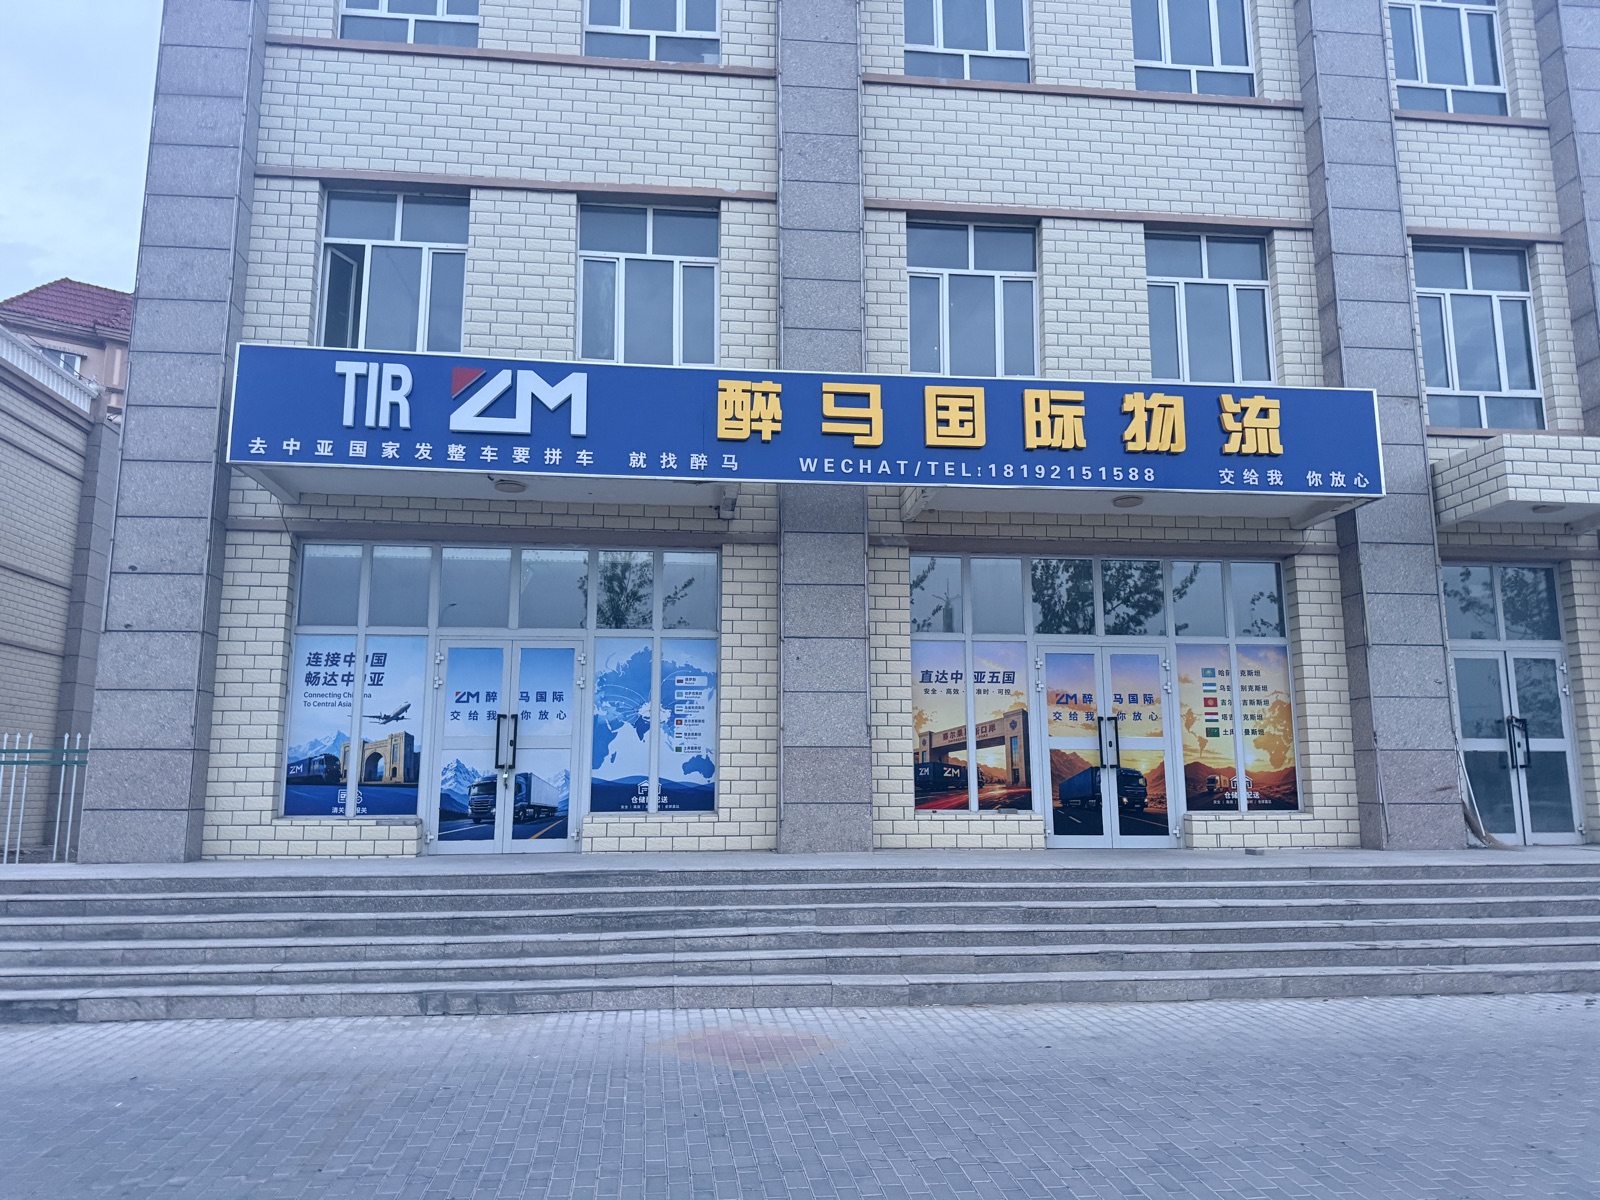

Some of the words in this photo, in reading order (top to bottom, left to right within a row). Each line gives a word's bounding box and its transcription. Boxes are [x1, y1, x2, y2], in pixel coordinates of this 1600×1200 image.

[335, 360, 413, 430] TIR
[450, 367, 588, 438] ZM
[716, 378, 1284, 456] 醉马国际物流
[248, 436, 594, 468] 去中亚国家发整车要拼车
[629, 451, 739, 472] 就找醉马
[799, 457, 1155, 482] WECHAT/TEL:18192151588
[1219, 468, 1284, 486] 交给我
[1306, 470, 1370, 488] 你放心
[919, 669, 1016, 685] 直达中亚五国
[303, 691, 342, 700] Connecting
[455, 691, 480, 704] ZM
[1056, 693, 1078, 705] ZM
[303, 700, 312, 708] To
[312, 700, 337, 708] Central
[337, 700, 352, 708] Asia
[520, 710, 567, 720] 你放心
[1053, 711, 1095, 722] 交给我
